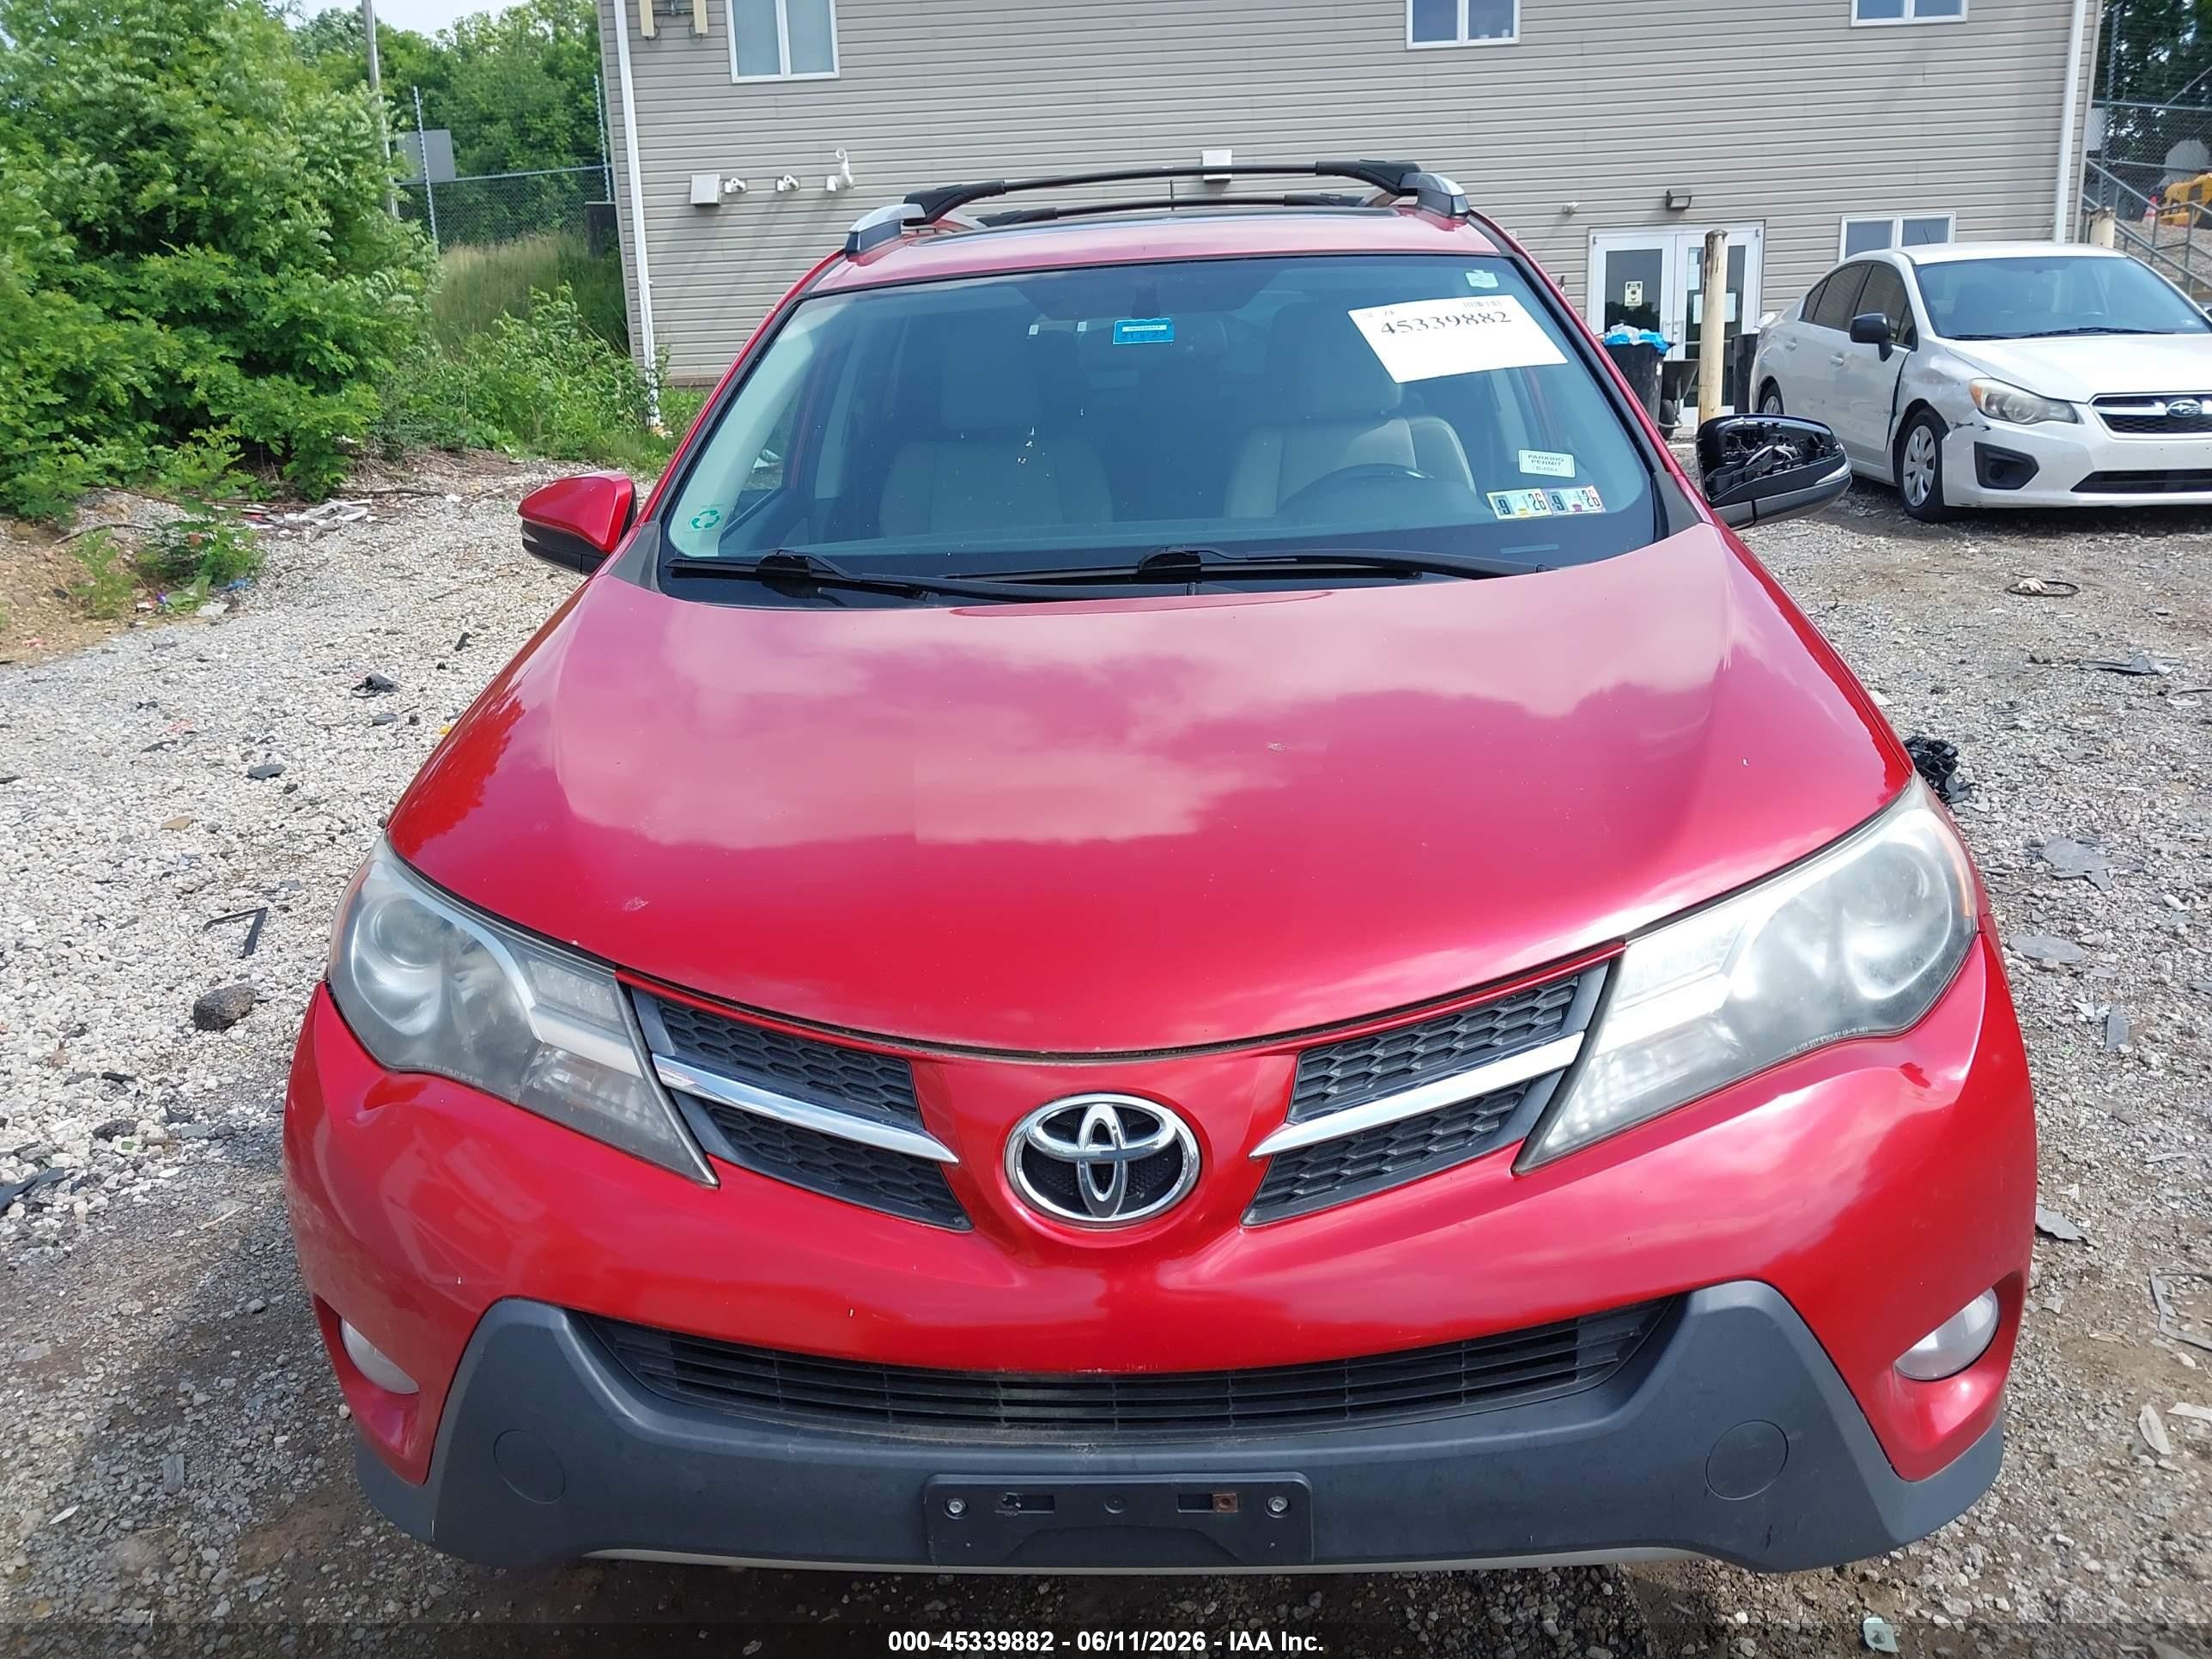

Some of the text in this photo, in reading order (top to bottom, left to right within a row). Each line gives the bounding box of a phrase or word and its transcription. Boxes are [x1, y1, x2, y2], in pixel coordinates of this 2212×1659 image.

[1381, 310, 1512, 334] 45339882
[1528, 453, 1565, 463] PARKING
[1531, 459, 1562, 467] PERMIT
[1498, 492, 1547, 515] 9 26
[1552, 489, 1601, 511] 9 26
